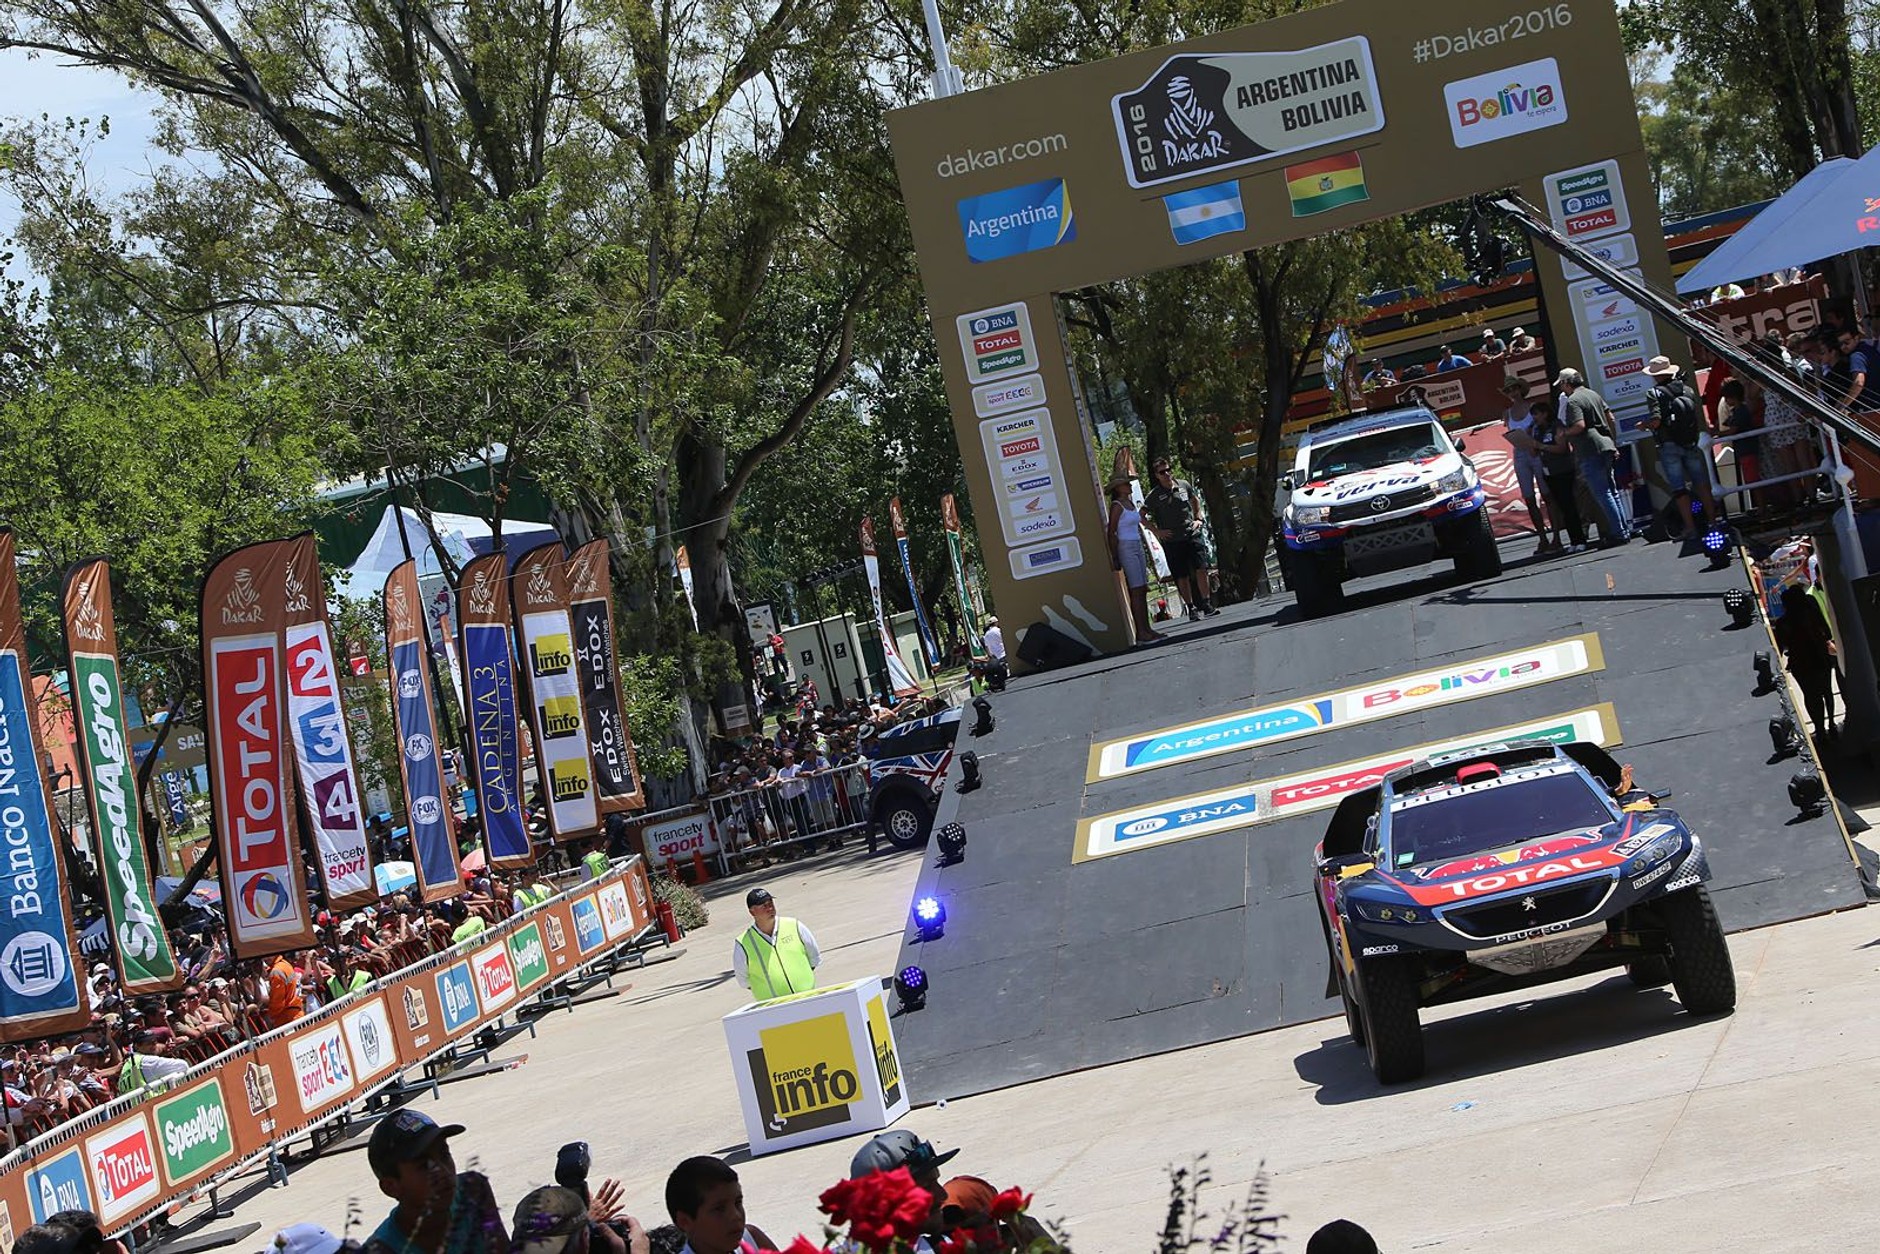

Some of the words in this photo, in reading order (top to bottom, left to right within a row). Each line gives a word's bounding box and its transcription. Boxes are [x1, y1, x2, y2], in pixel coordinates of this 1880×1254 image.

[1412, 3, 1573, 64] #Dakar2016
[1236, 58, 1360, 110] ARGENTINA
[1281, 90, 1367, 132] BOLIVIA
[1456, 84, 1554, 127] Bolivia
[1130, 103, 1158, 173] 2016
[1162, 130, 1230, 167] DAKAR
[937, 131, 1068, 178] dakar.com
[1584, 193, 1609, 207] BNA
[967, 202, 1059, 240] Argentina
[1569, 215, 1613, 230] TOTAL
[991, 316, 1014, 329] BNA
[1597, 324, 1635, 340] sodexo
[977, 335, 1018, 350] TOTAL
[981, 353, 1021, 370] SpeedAgro
[1606, 362, 1643, 376] TOYOTA
[1003, 441, 1038, 455] TOYOTA
[1020, 519, 1057, 534] sodexo
[469, 599, 496, 615] DAKAR
[527, 590, 557, 604] DAKAR
[222, 605, 264, 626] DAKAR
[76, 619, 107, 644] DAKAR
[539, 650, 572, 670] info
[586, 614, 606, 691] EDOX
[296, 648, 331, 690] 2
[401, 674, 421, 690] FOX
[473, 666, 495, 680] 3
[1362, 660, 1541, 710] Bolivia
[309, 716, 344, 757] 3
[496, 659, 518, 814] ARGENTINA
[548, 713, 580, 731] info
[1151, 712, 1300, 755] Argentina
[235, 656, 277, 864] TOTAL
[476, 689, 510, 815] CADENA
[599, 709, 623, 783] EDOX
[557, 775, 588, 794] info
[1279, 770, 1386, 801] TOTA
[86, 670, 158, 962] SpeedAgro
[324, 780, 356, 823] 4
[417, 800, 437, 816] FOX
[1177, 801, 1248, 826] BNA
[658, 832, 705, 857] sport
[2, 806, 43, 919] Banco
[329, 855, 366, 881] sport
[1440, 856, 1604, 897] TOTAL
[1665, 874, 1702, 892] sparco
[1495, 921, 1574, 944] PEUGEOT
[1362, 944, 1399, 957] sparco
[485, 962, 512, 992] TOTAL
[772, 1065, 812, 1083] france
[879, 1040, 898, 1086] info
[302, 1064, 325, 1101] sport
[775, 1062, 857, 1115] info
[165, 1103, 225, 1161] SpeedAgro
[107, 1148, 151, 1190] TOTAL
[58, 1179, 83, 1212] BNA
